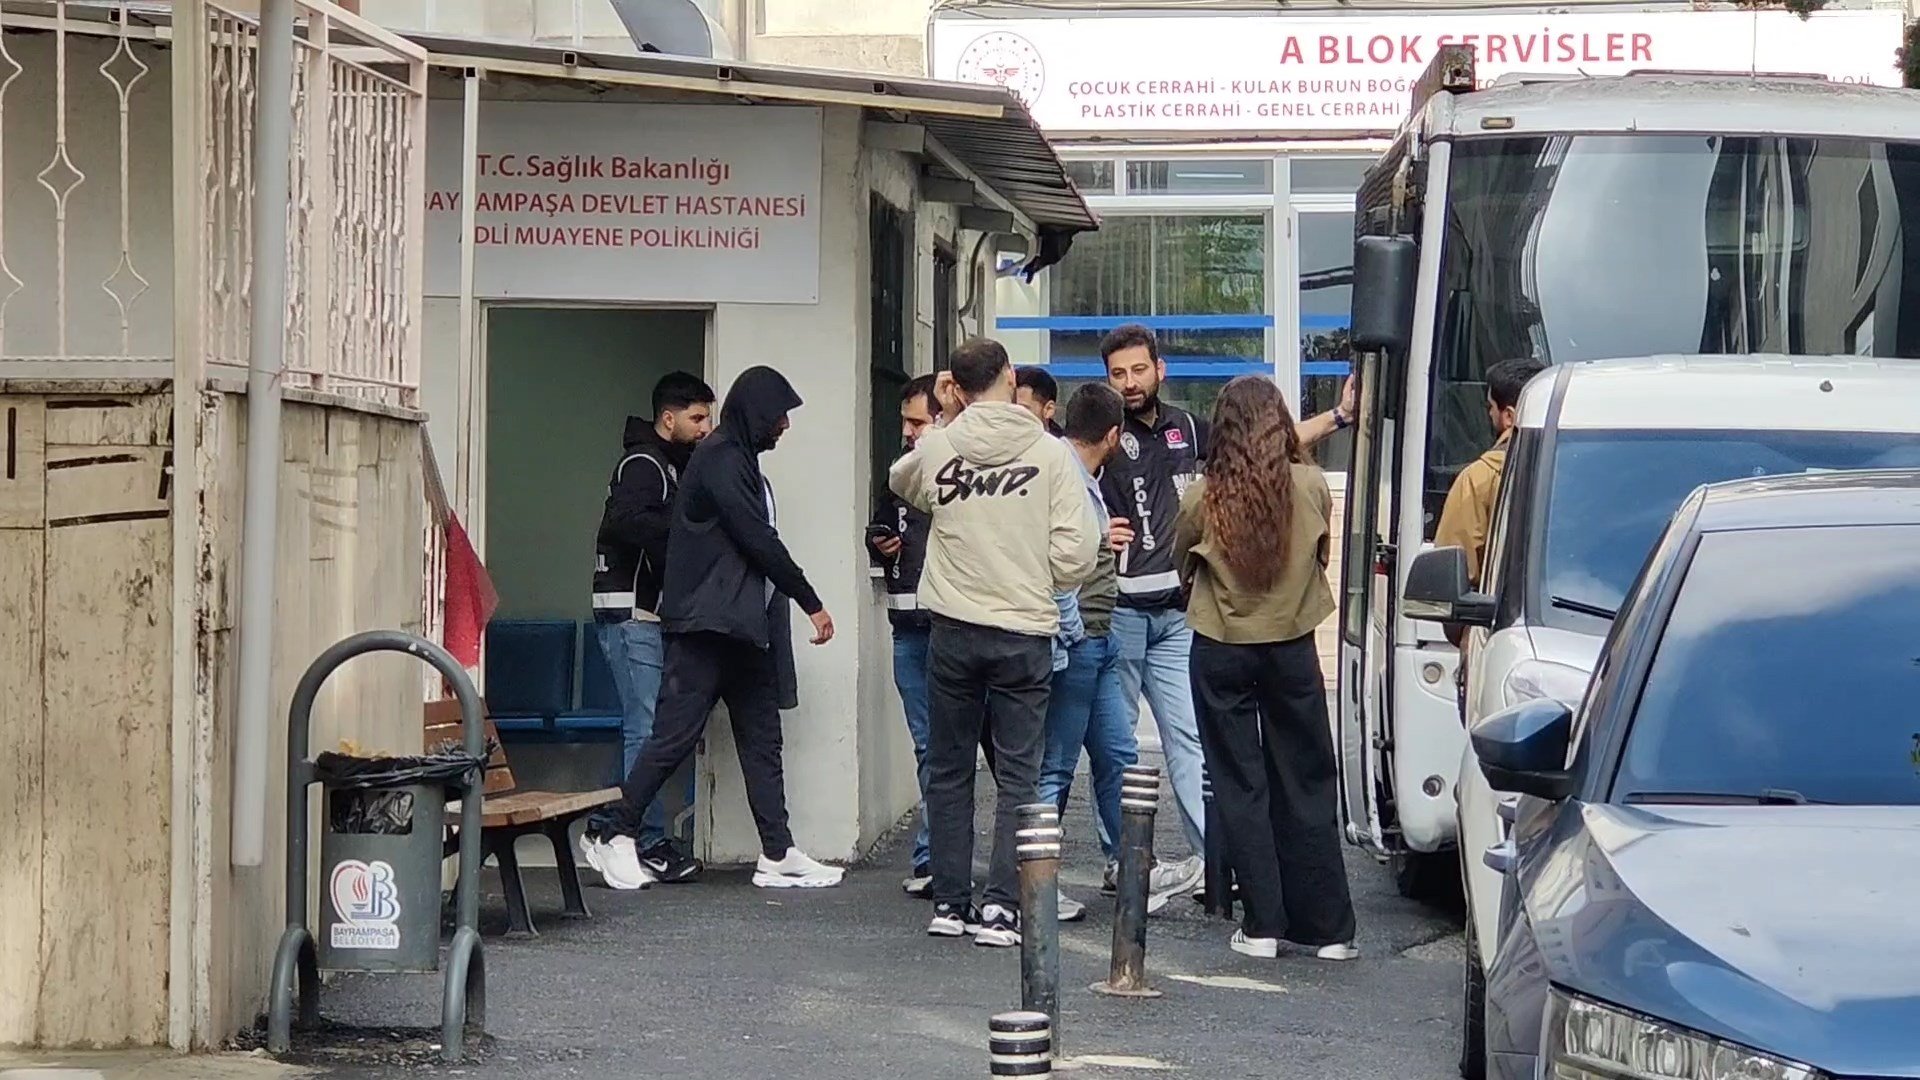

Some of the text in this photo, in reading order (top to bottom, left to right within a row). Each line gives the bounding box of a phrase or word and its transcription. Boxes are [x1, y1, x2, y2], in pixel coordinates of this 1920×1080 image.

[1280, 35, 1305, 65] A
[1318, 34, 1423, 65] BLOK
[1068, 81, 1131, 99] ÇOCUK
[1136, 77, 1215, 95] CERRAHİ
[1231, 80, 1292, 94] KULAK
[1298, 79, 1361, 94] BURUN
[1367, 76, 1416, 93] BOĞA
[1081, 101, 1156, 118] PLASTİK
[1161, 101, 1241, 117] CERRAHİ
[1257, 102, 1316, 117] GENEL
[1321, 99, 1401, 117] CERRAHİ
[611, 155, 730, 186] Bakanlığı
[424, 192, 806, 218] AYAMPAŞA DEVLET HASTANESİ
[458, 223, 760, 250] DLİ MUAYENE POLİKLİNİĞİ
